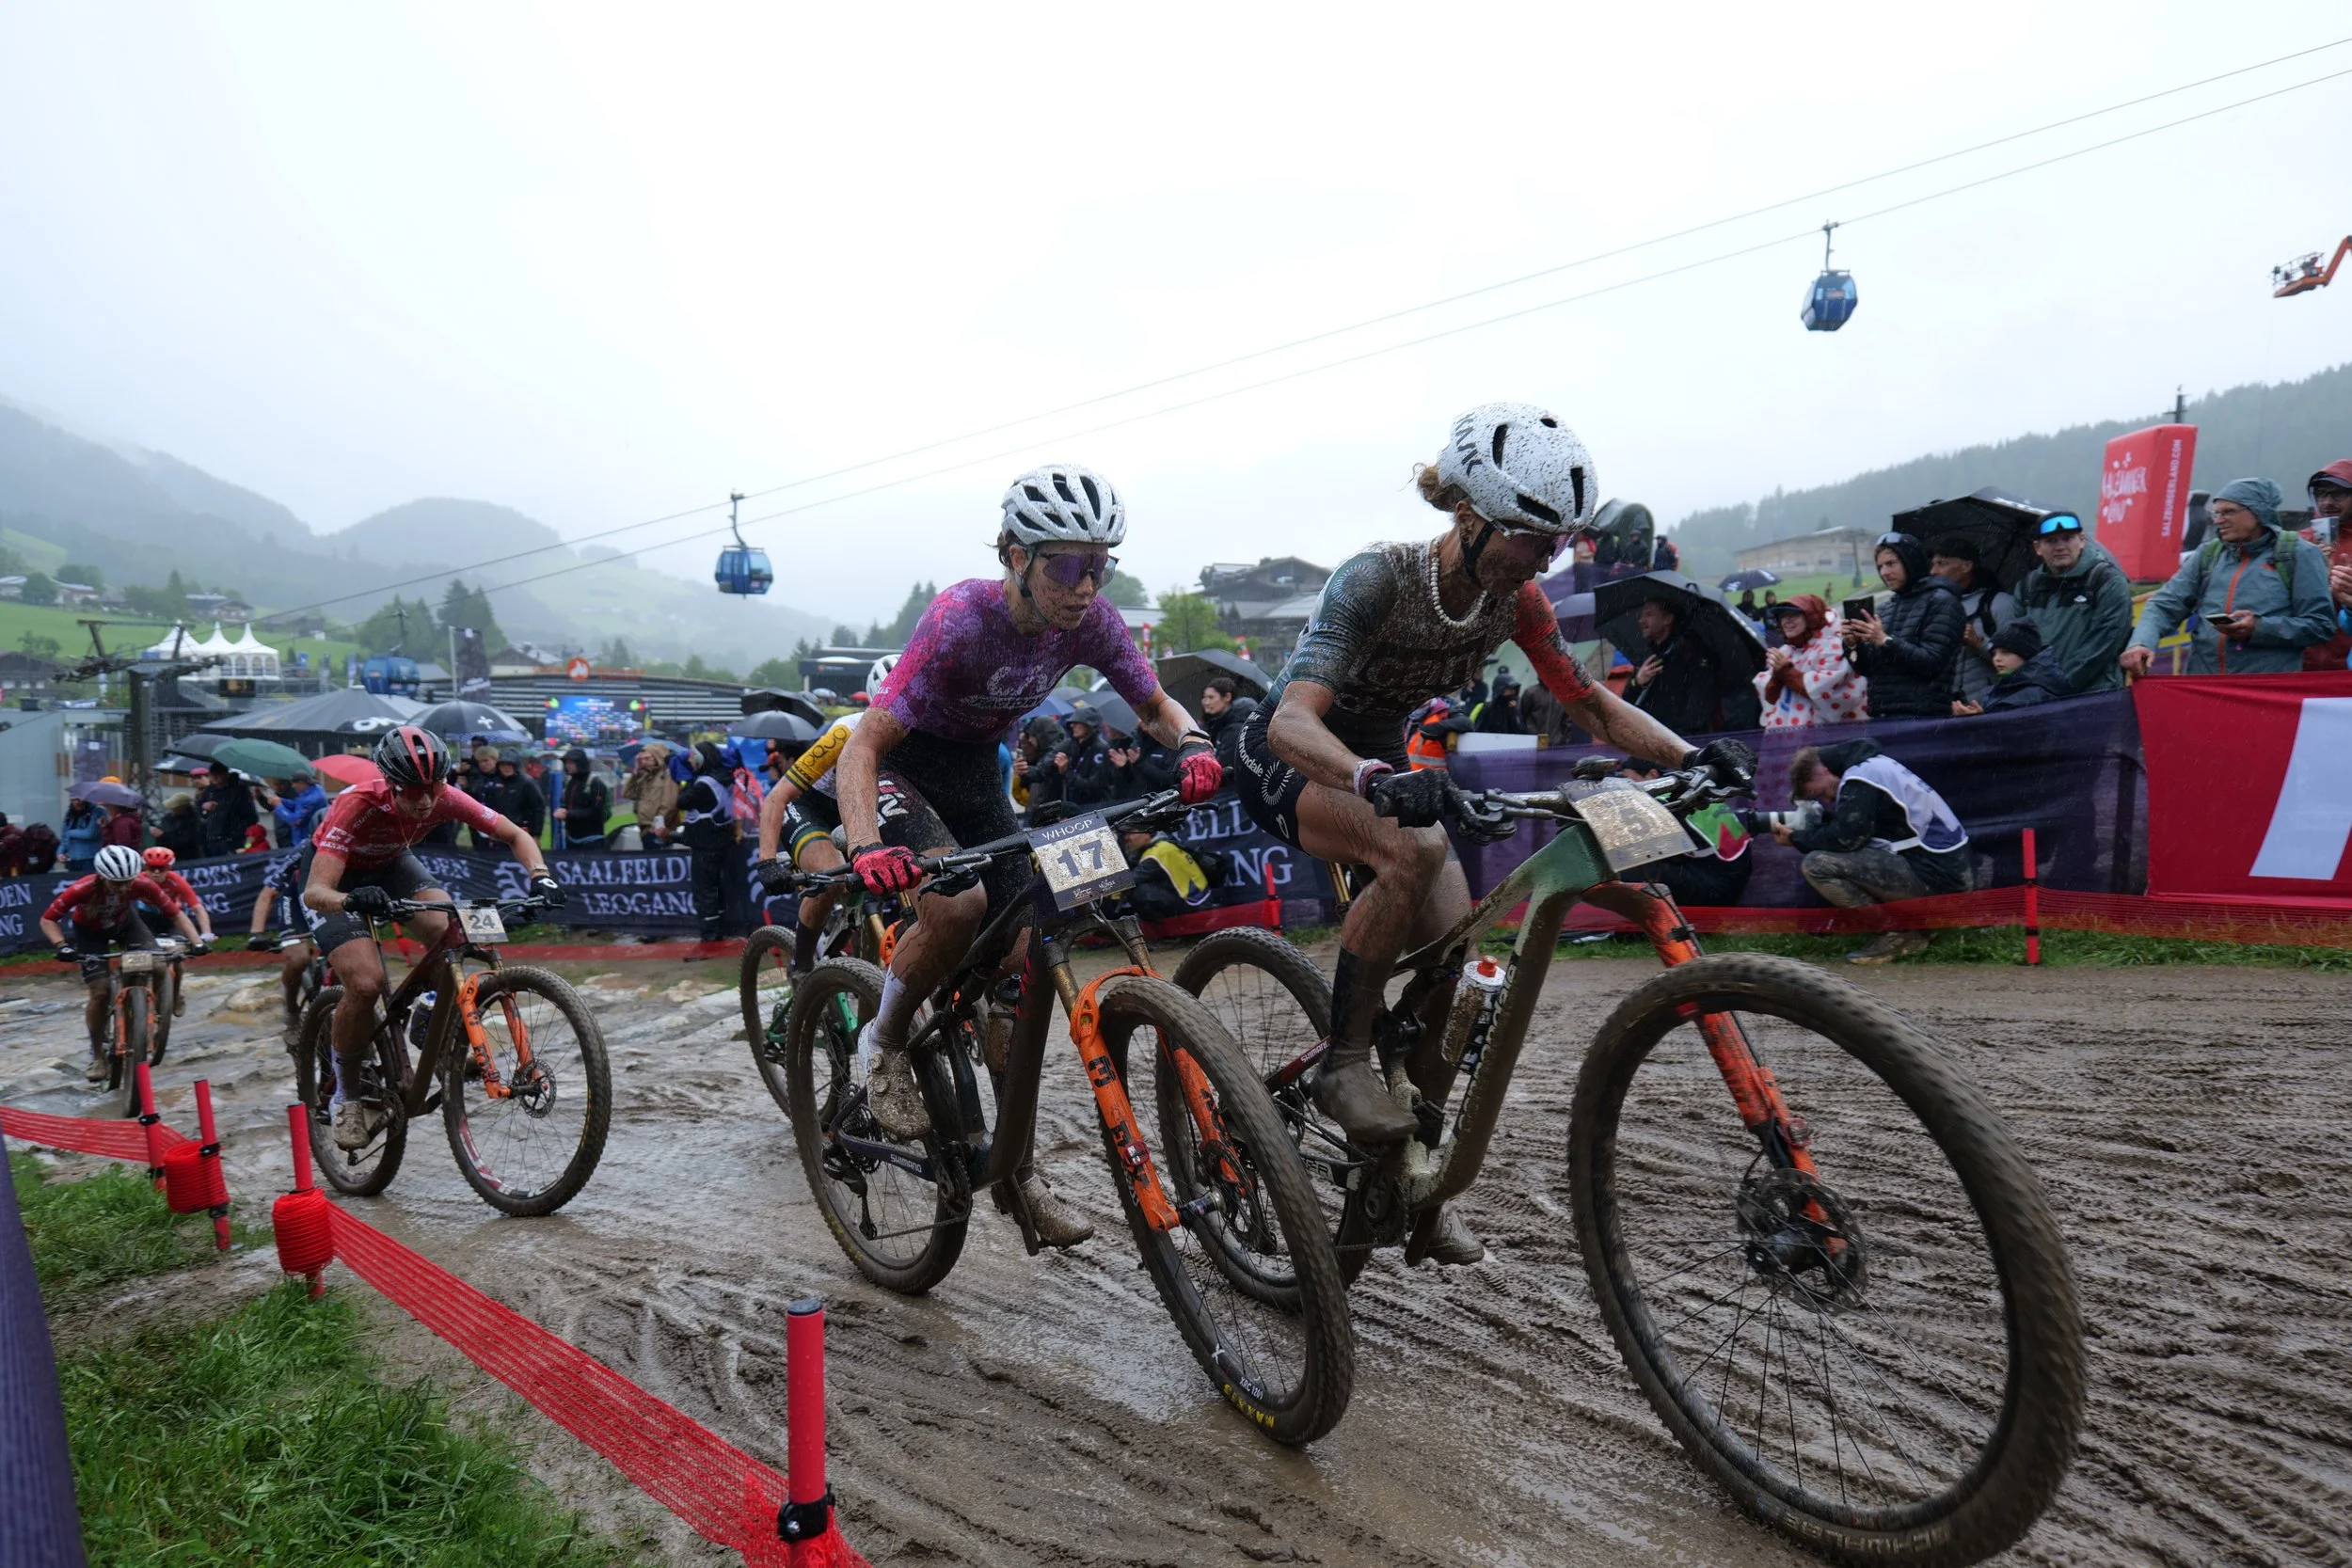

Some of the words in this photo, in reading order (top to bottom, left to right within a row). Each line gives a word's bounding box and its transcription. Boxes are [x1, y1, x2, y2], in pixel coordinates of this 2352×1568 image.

[1238, 725, 1263, 778] cannondale
[1041, 819, 1092, 841] WHOOP
[1619, 808, 1651, 837] 5
[555, 855, 691, 885] SAALFELD
[1057, 839, 1104, 879] 17
[469, 914, 496, 930] 24
[890, 1153, 923, 1174] SHIMANO
